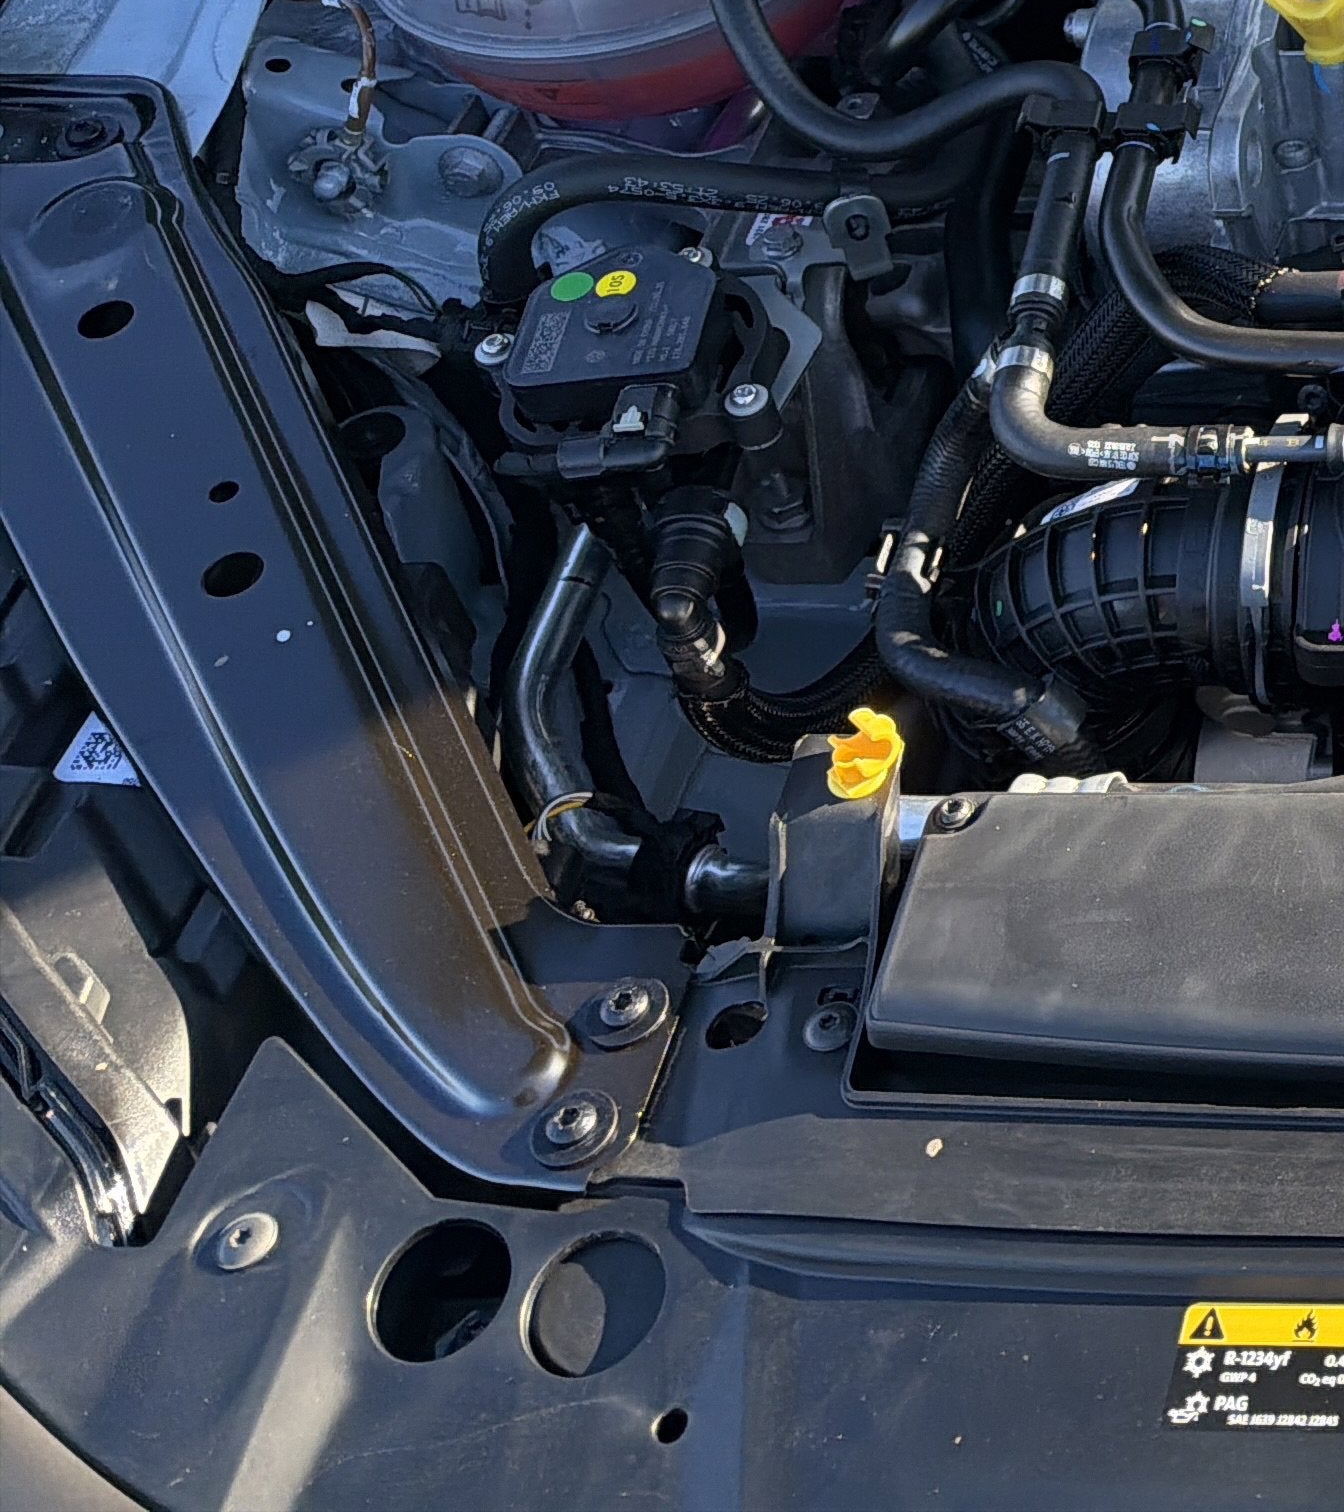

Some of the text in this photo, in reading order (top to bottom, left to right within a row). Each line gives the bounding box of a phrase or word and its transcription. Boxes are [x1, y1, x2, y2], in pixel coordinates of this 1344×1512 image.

[606, 274, 625, 294] 105
[1223, 1350, 1292, 1370] R-1234yf
[1322, 1375, 1336, 1387] eq
[1213, 1395, 1249, 1412] PAG
[1226, 1414, 1249, 1426] SAE
